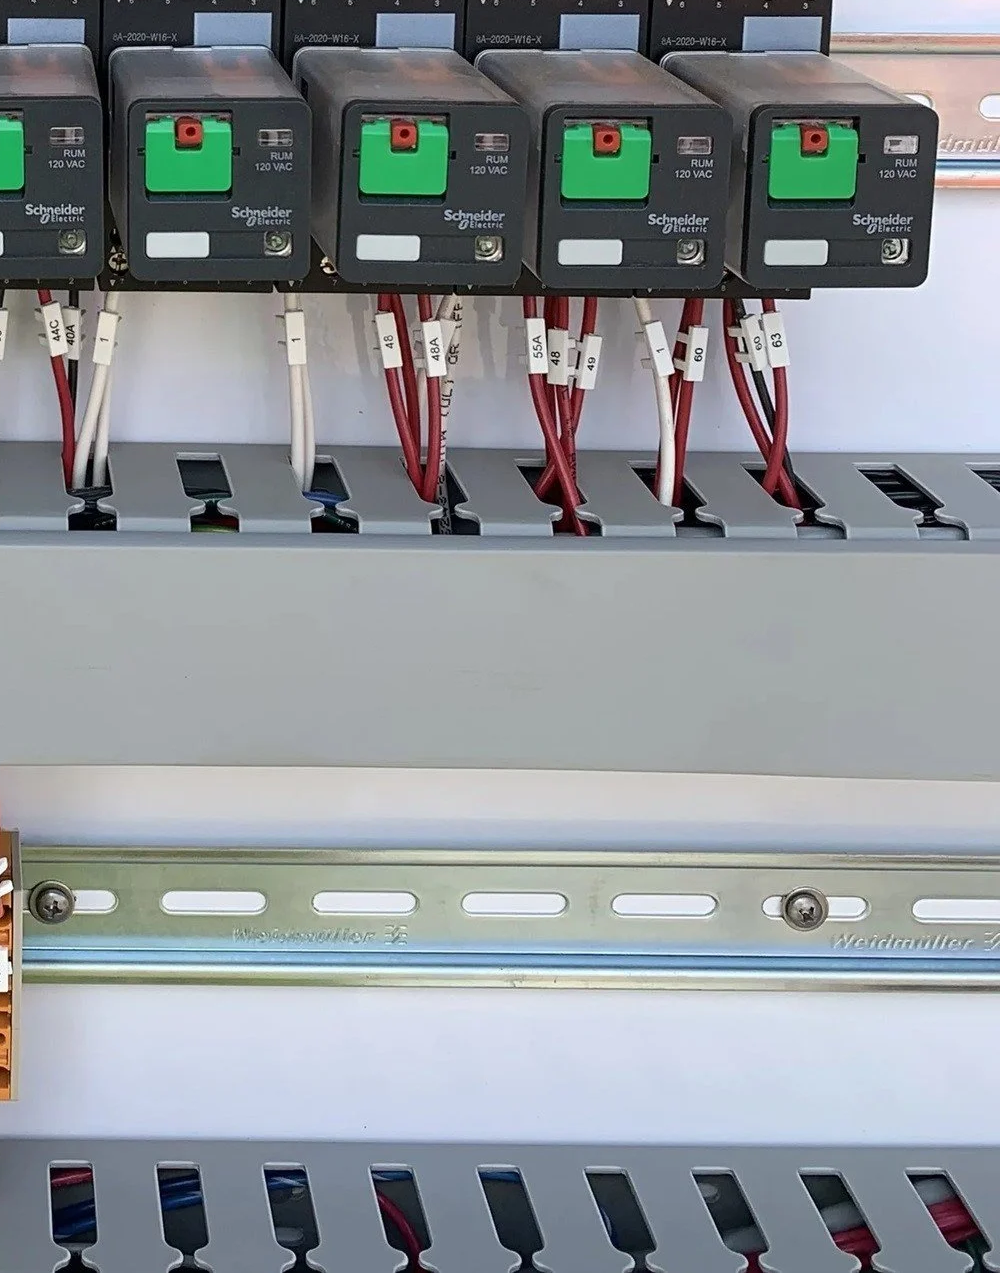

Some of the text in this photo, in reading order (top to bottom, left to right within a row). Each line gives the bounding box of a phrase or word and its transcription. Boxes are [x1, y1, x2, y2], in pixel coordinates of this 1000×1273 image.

[270, 152, 293, 161] RUM
[895, 159, 918, 167] RUM
[255, 163, 293, 172] 120 VAC
[879, 170, 917, 178] 120 VAC
[231, 207, 293, 219] Schneider
[257, 217, 292, 226] Electric
[852, 214, 913, 226] Schneider
[878, 225, 912, 233] Electric
[49, 318, 63, 341] 44C
[383, 335, 394, 349] 48
[532, 335, 543, 358] 55A
[771, 333, 782, 347] 63
[429, 337, 440, 361] 48A
[549, 351, 560, 368] 48
[587, 357, 598, 373] 49
[832, 932, 976, 951] Weidmüller
